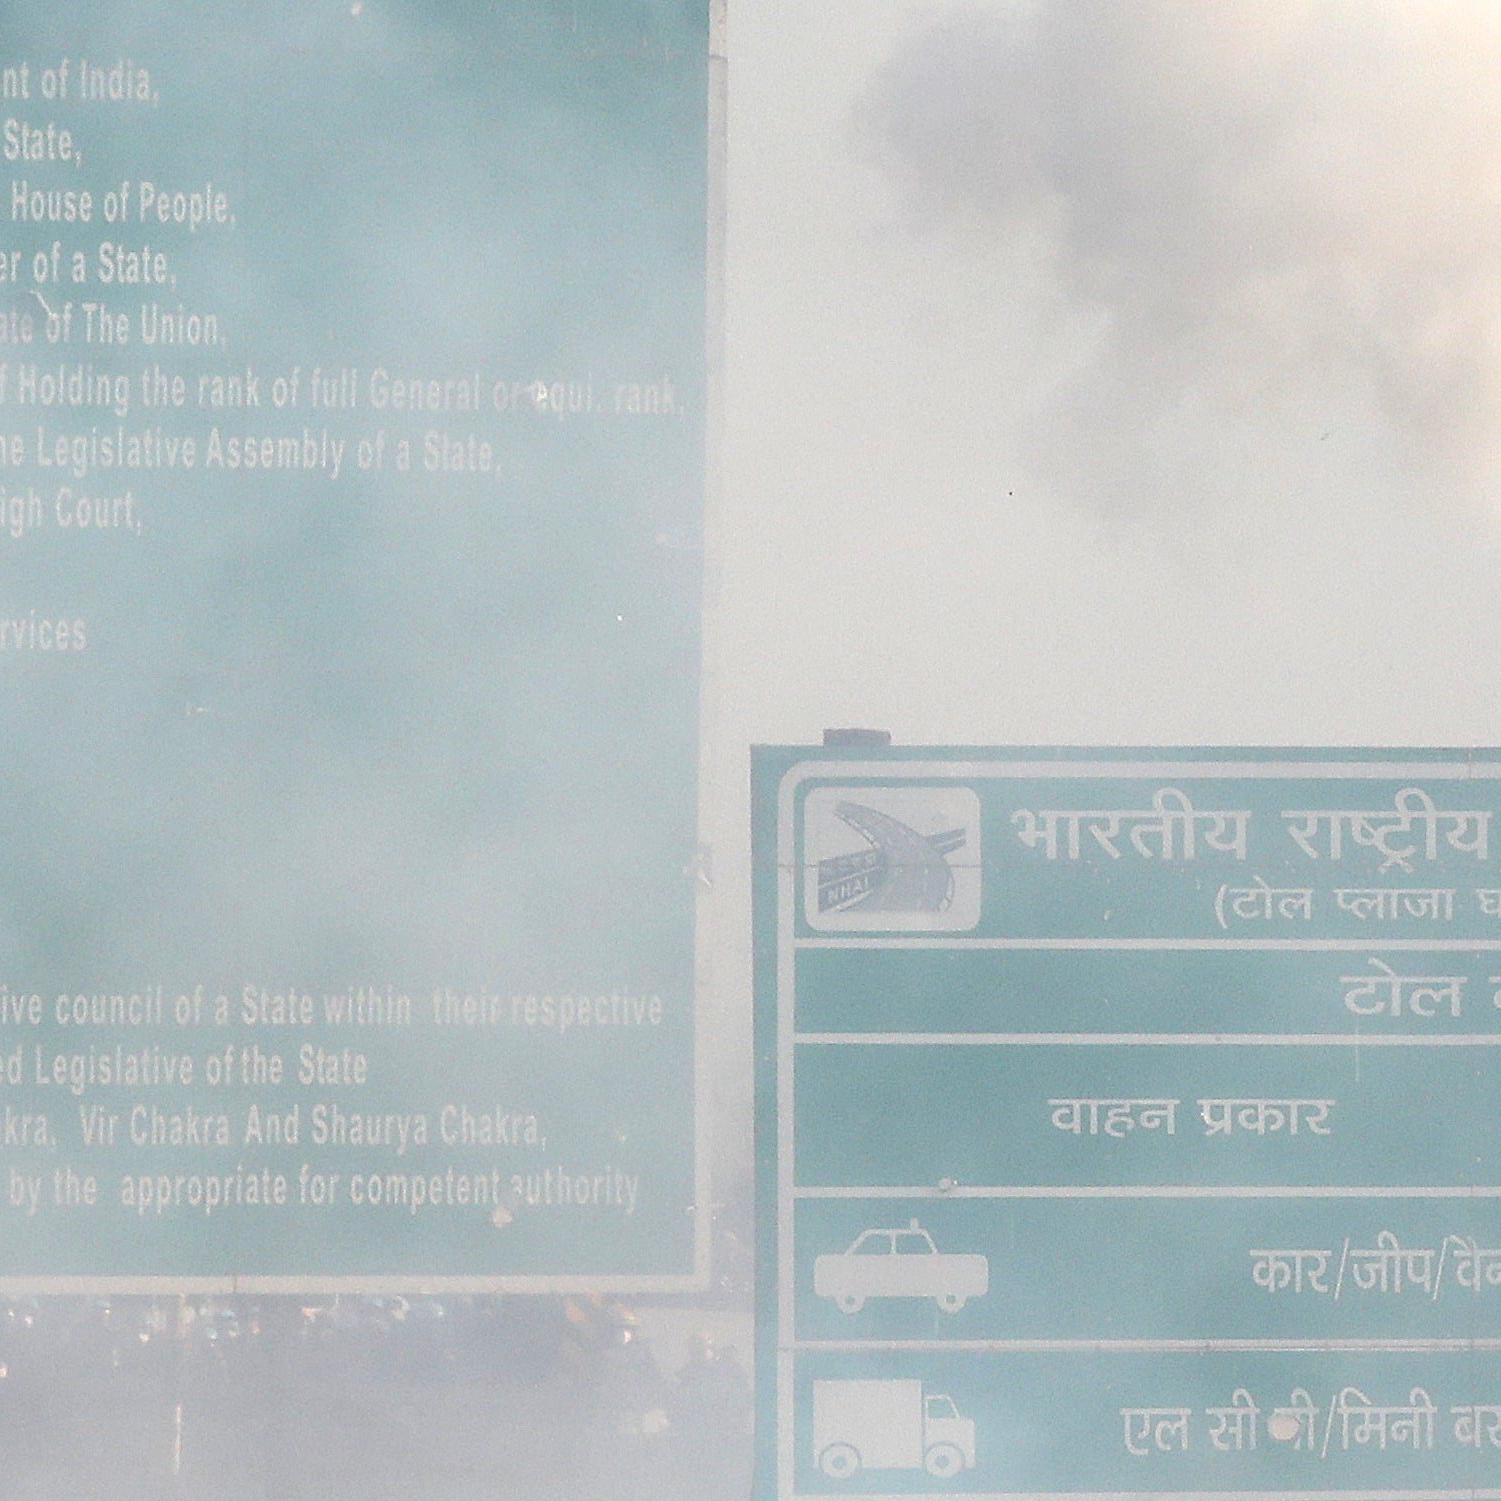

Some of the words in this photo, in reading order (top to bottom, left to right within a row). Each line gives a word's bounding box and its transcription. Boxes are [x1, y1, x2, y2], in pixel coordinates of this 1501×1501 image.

[42, 58, 70, 99] of
[81, 61, 160, 108] India,
[4, 119, 82, 168] State,
[12, 181, 91, 222] House
[103, 180, 131, 222] of
[33, 242, 61, 283] of
[72, 252, 85, 283] a
[100, 243, 177, 290] State,
[45, 303, 72, 344] of
[83, 304, 129, 344] The
[37, 426, 195, 477] Legislative
[206, 428, 345, 479] Assembly
[359, 429, 384, 471] of
[398, 441, 409, 472] a
[1011, 788, 1252, 861] भारतीय
[1281, 787, 1493, 874] राष्ट्रीय
[1214, 876, 1313, 927] (टोल
[1334, 888, 1456, 920] प्लाजा
[55, 984, 162, 1026] council
[175, 983, 203, 1026] of
[215, 992, 228, 1025] a
[242, 984, 313, 1026] State
[324, 985, 412, 1026] within
[433, 985, 499, 1026] their
[510, 985, 663, 1034] respective
[1341, 958, 1466, 1018] टोल
[35, 1043, 193, 1094] Legislative
[205, 1044, 233, 1084] of
[240, 1044, 283, 1084] the
[299, 1042, 367, 1085] State
[79, 1104, 118, 1146] Vir
[245, 1103, 298, 1145] And
[312, 1103, 428, 1155] Shaurya
[440, 1103, 547, 1151] Chakra,
[1048, 1099, 1179, 1138] वाहन
[1197, 1099, 1335, 1136] प्रकार
[10, 1164, 40, 1218] by
[55, 1164, 97, 1206] the
[121, 1165, 287, 1216] appropriate
[299, 1163, 339, 1204] for
[351, 1167, 499, 1213] competent
[1120, 1405, 1191, 1456] एल
[1208, 1389, 1260, 1451] सी
[1269, 1388, 1438, 1459] ी/मिनी
